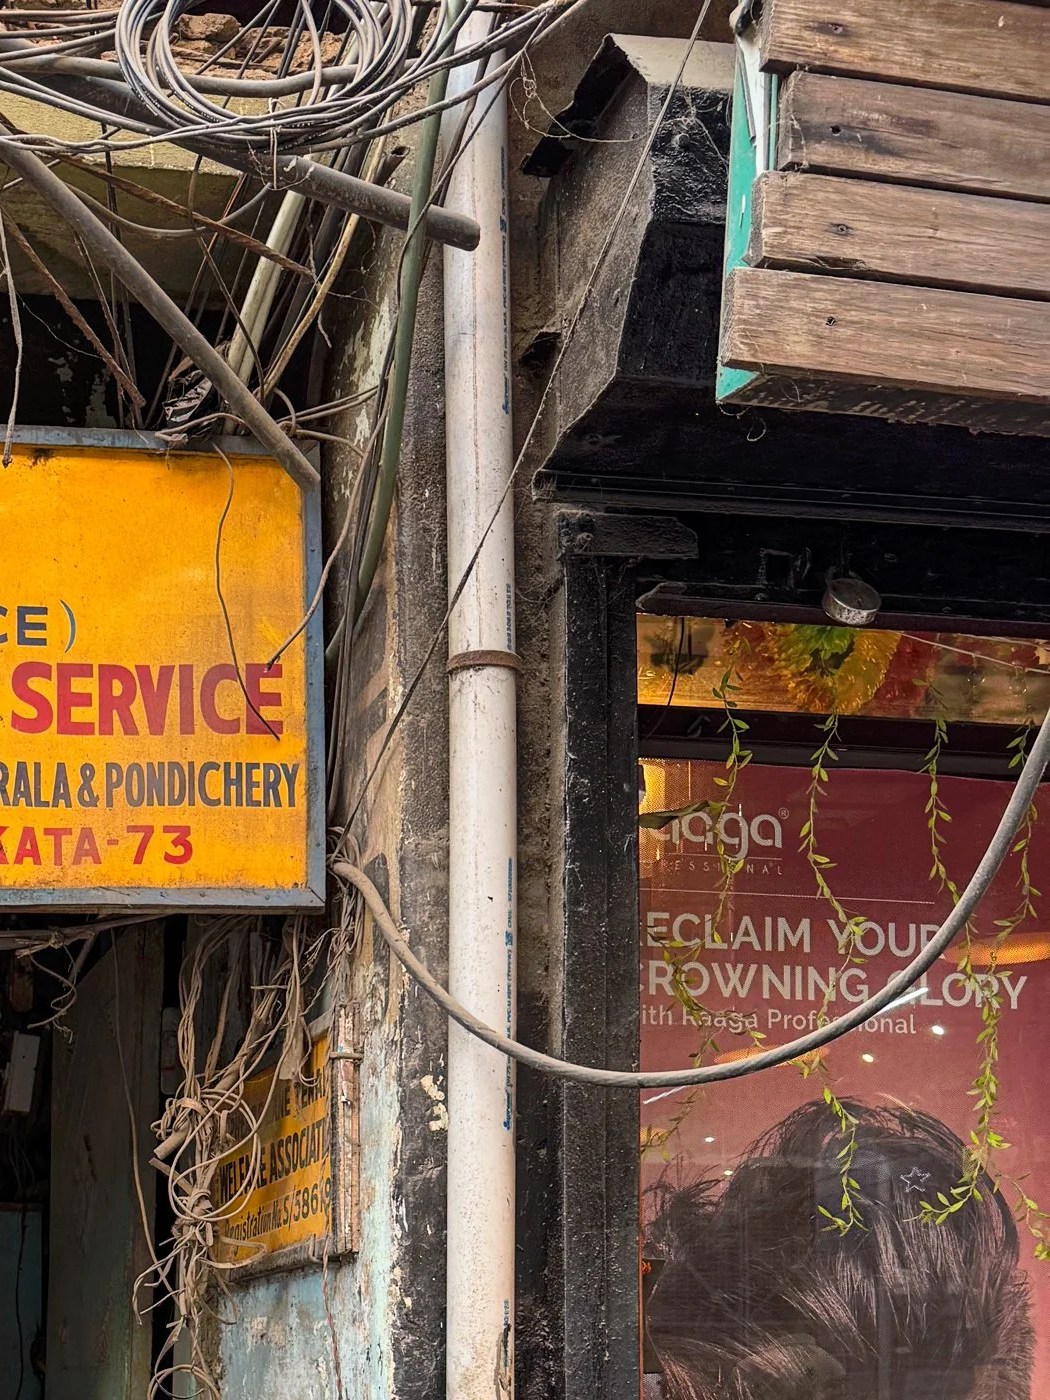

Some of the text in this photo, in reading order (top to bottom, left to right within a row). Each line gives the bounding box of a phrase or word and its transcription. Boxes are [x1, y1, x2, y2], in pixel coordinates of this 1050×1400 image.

[10, 661, 284, 737] SERVICE
[640, 911, 810, 953] ECLAIM
[640, 959, 868, 1004] ROWNING
[641, 1004, 673, 1026] ith
